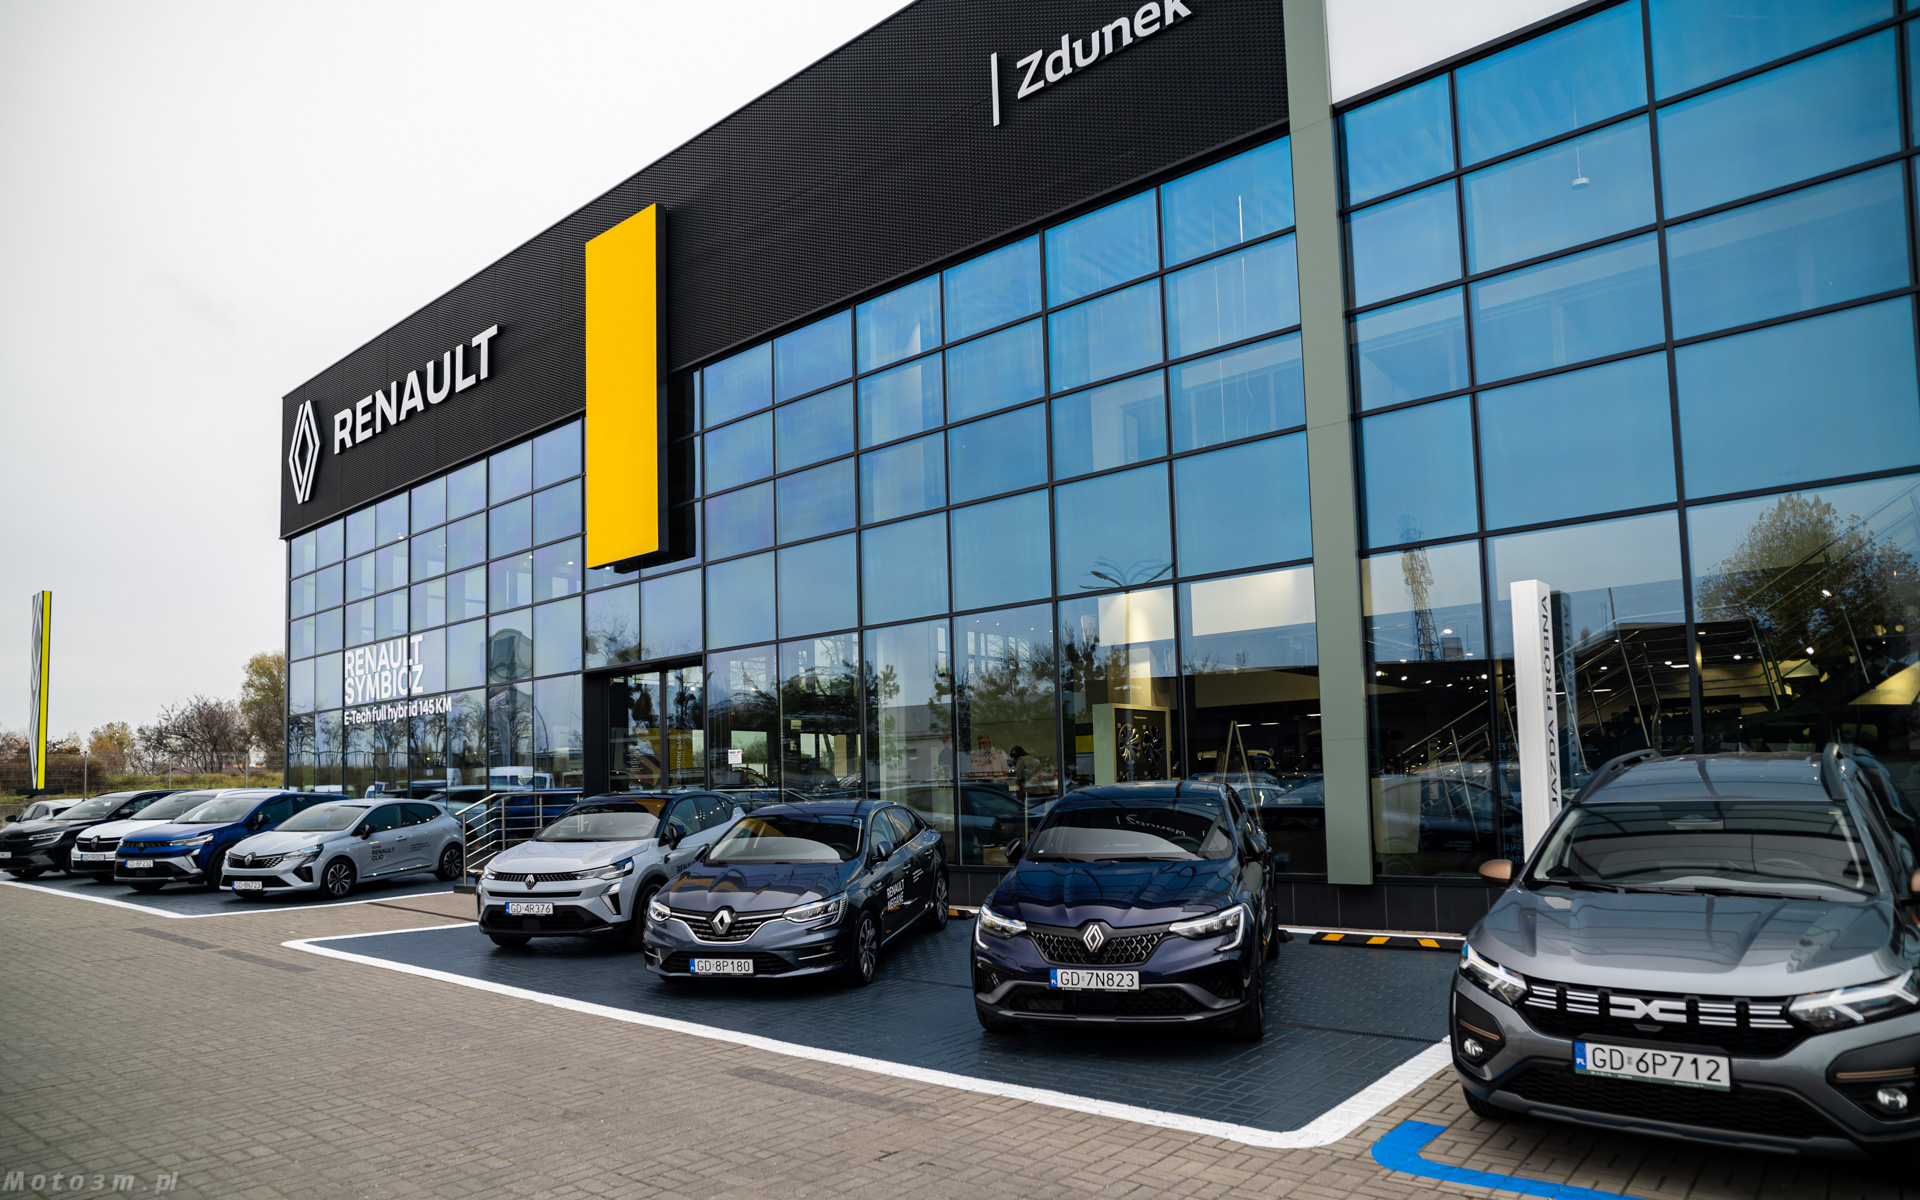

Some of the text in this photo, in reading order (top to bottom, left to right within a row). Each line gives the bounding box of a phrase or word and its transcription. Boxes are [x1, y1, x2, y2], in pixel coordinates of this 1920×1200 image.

[1016, 0, 1192, 100] Zdunek
[334, 324, 498, 455] RENAULT
[344, 635, 424, 678] RENAULT
[344, 664, 424, 705] SYMBIOZ
[344, 696, 452, 725] E-Tech full hybrid 145 KM
[1541, 595, 1559, 808] JAZDA PRÓBNA
[371, 847, 395, 855] RENAULT
[887, 879, 904, 899] RENAULT
[511, 904, 551, 913] GD 4R376
[697, 960, 711, 971] GD
[716, 960, 750, 972] 8P180
[1060, 971, 1135, 988] GD 7N823
[1592, 1047, 1721, 1083] GD 6P712
